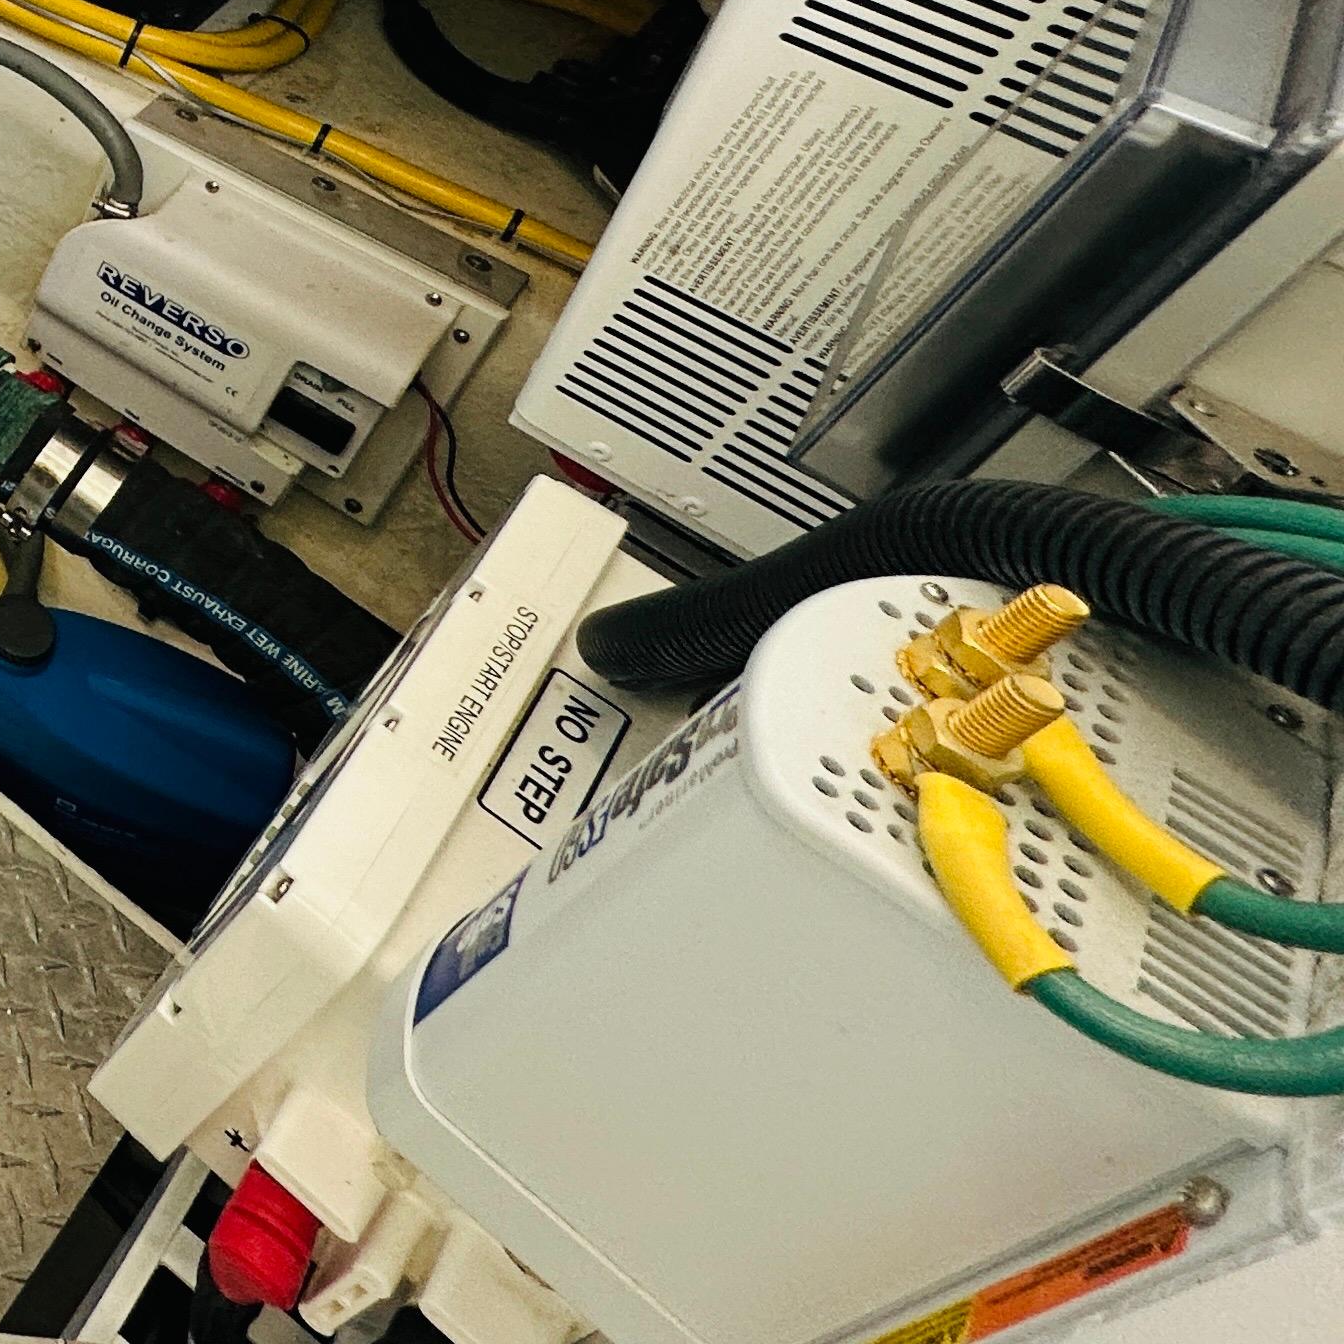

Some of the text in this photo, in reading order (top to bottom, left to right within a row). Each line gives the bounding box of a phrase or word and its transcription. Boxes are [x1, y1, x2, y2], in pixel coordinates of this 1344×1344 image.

[97, 260, 253, 362] REVERSO
[98, 289, 120, 308] Oil
[118, 302, 174, 341] Change
[172, 333, 228, 374] System
[81, 527, 171, 585] CORRUGAT
[171, 576, 248, 634] EXHAUST
[242, 625, 283, 659] WET
[432, 605, 540, 762] STOP/START ENGINE
[513, 694, 600, 825] NO STEP
